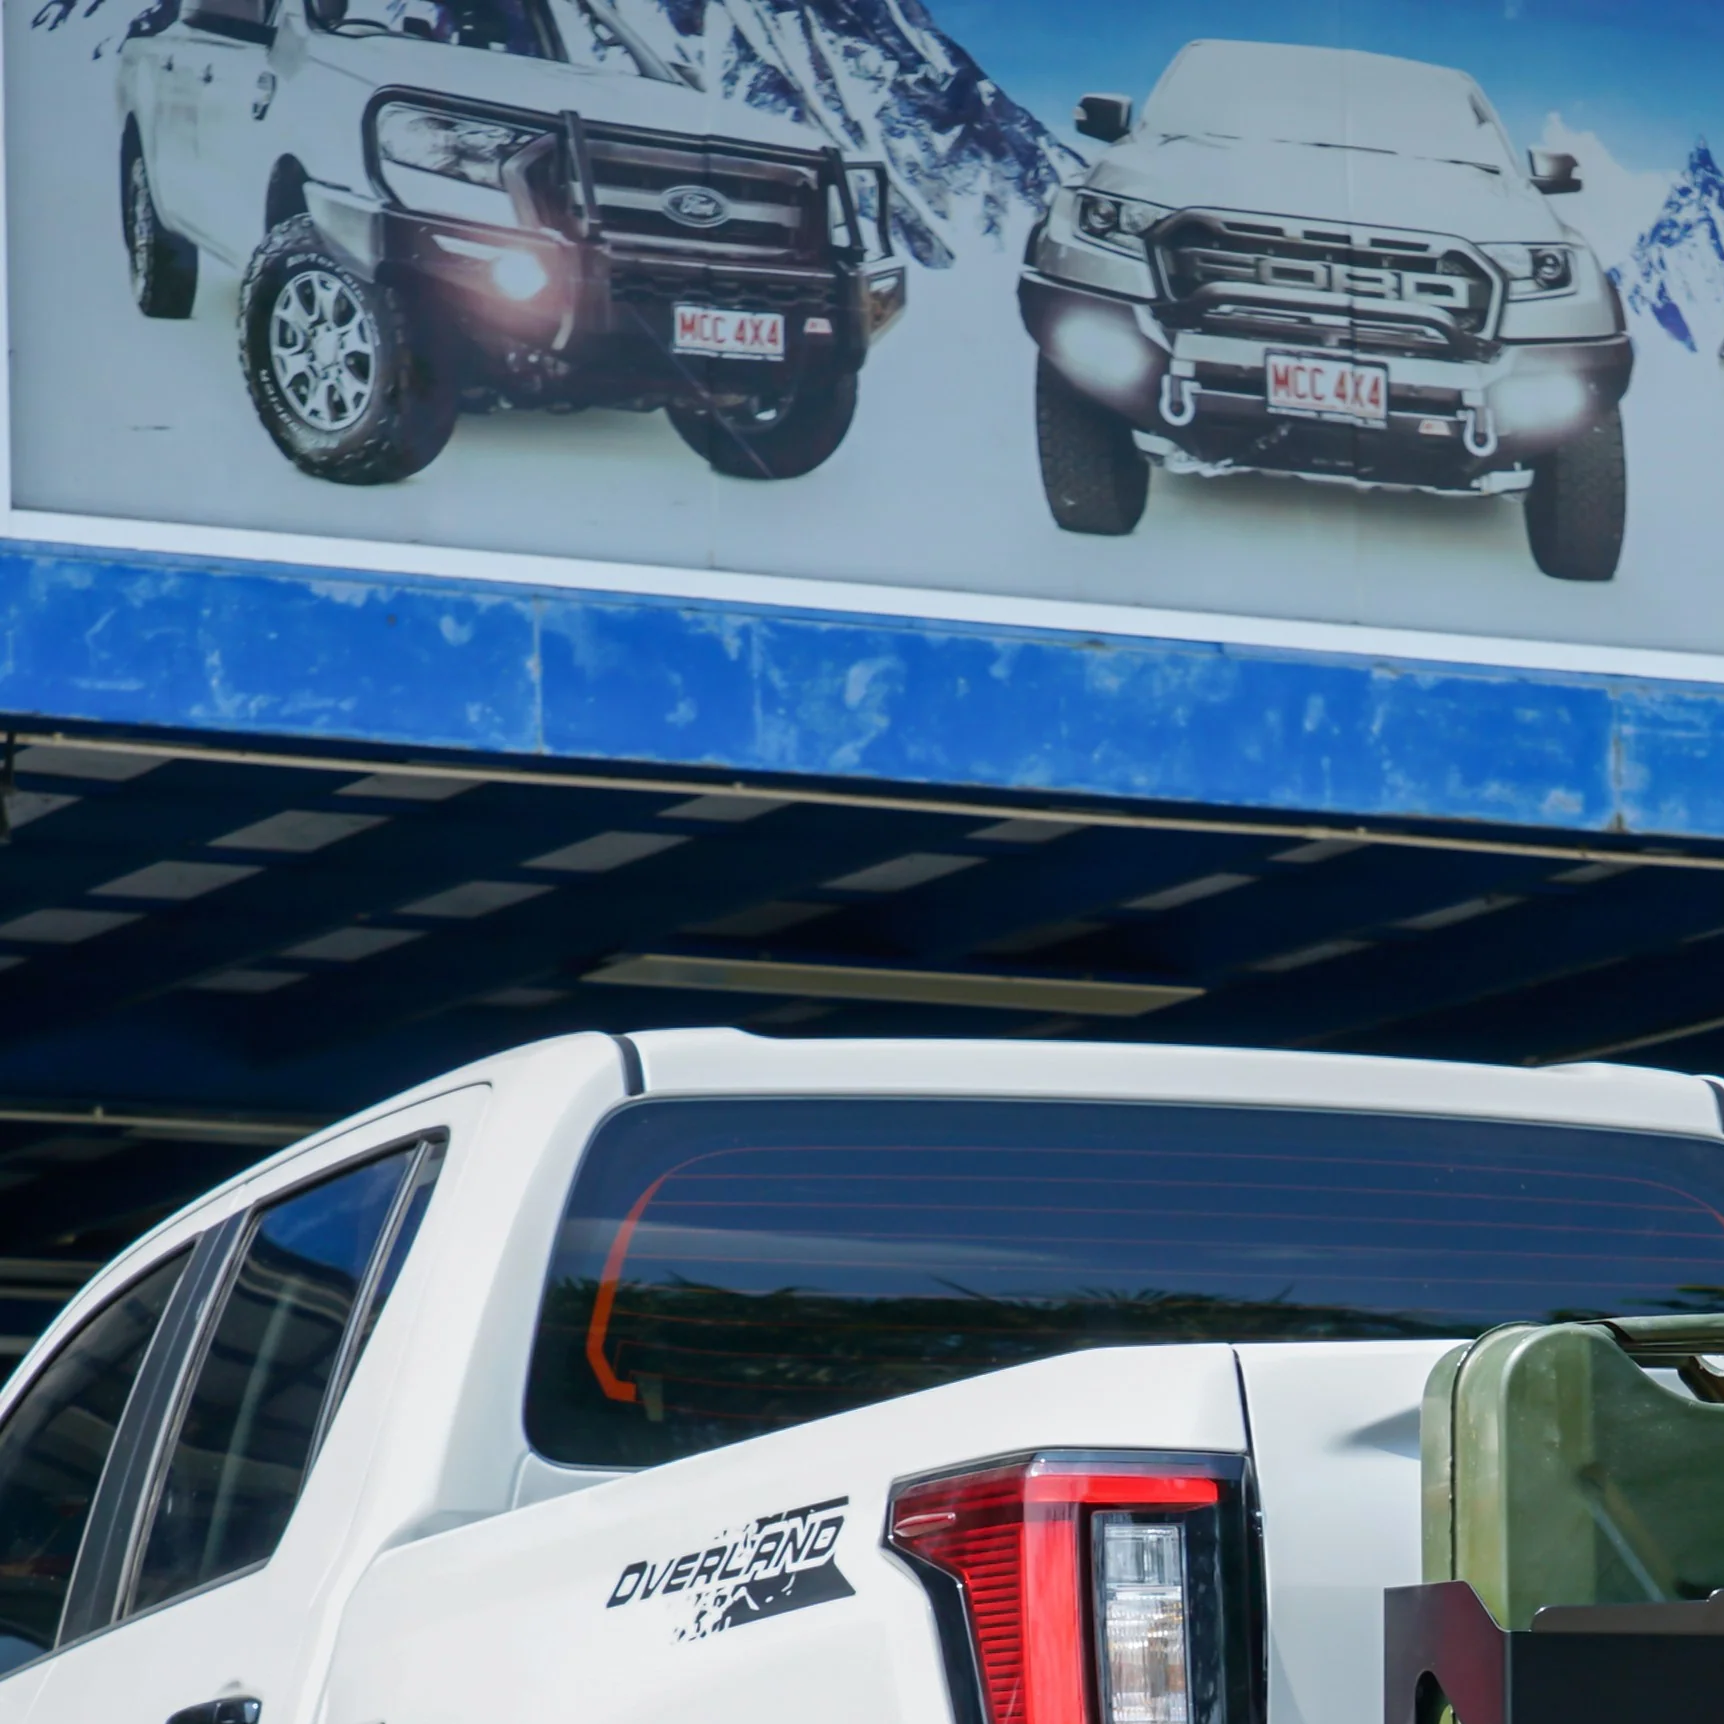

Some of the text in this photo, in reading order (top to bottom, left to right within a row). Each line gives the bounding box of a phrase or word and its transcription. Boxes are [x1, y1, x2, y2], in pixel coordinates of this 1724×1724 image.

[680, 312, 726, 344] MCC
[734, 319, 779, 346] 4X4
[1272, 364, 1381, 408] MCC 4X4
[606, 1515, 844, 1609] OVERLAND
